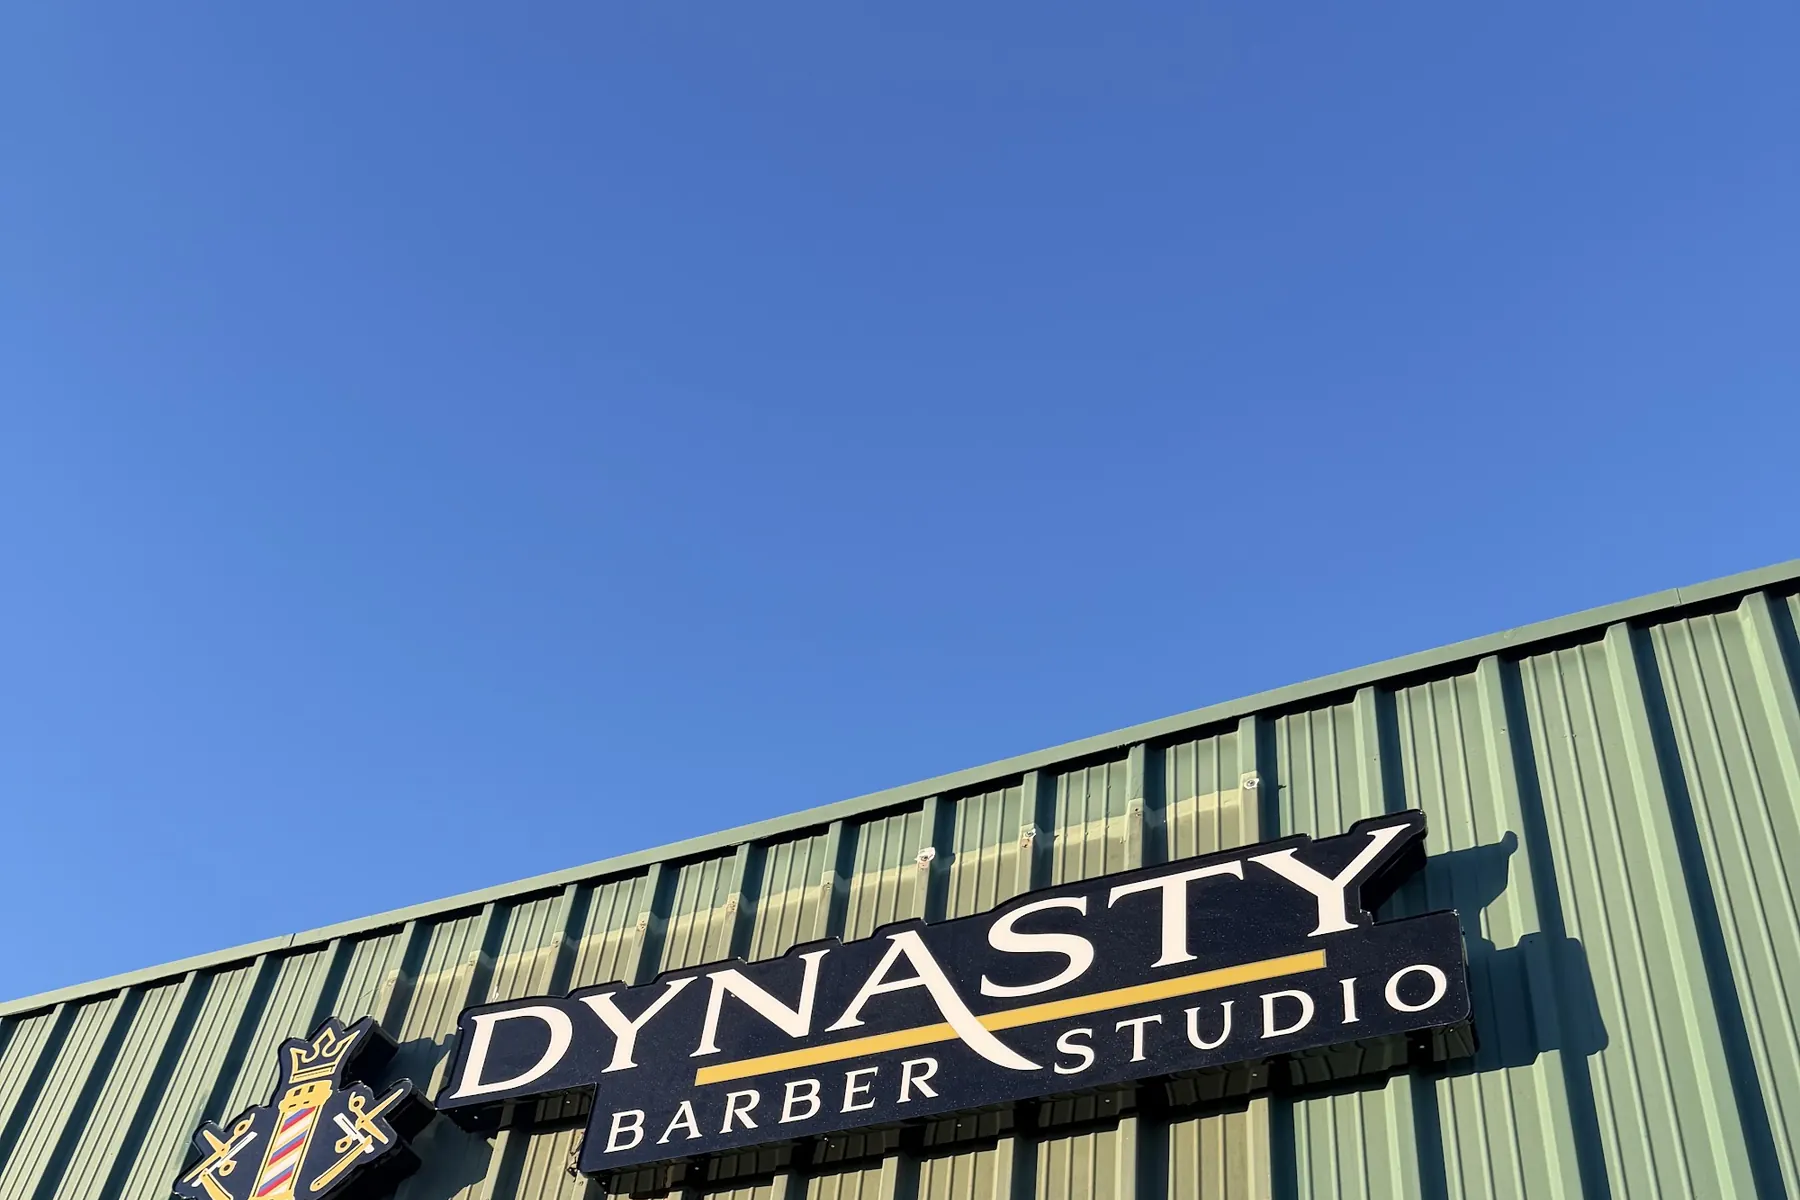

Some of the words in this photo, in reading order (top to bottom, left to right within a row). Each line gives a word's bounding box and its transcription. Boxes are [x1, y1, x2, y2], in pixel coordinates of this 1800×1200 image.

[449, 823, 1411, 1100] DYNASTY
[603, 1057, 940, 1154] BARBER
[1053, 964, 1448, 1075] STUDIO
